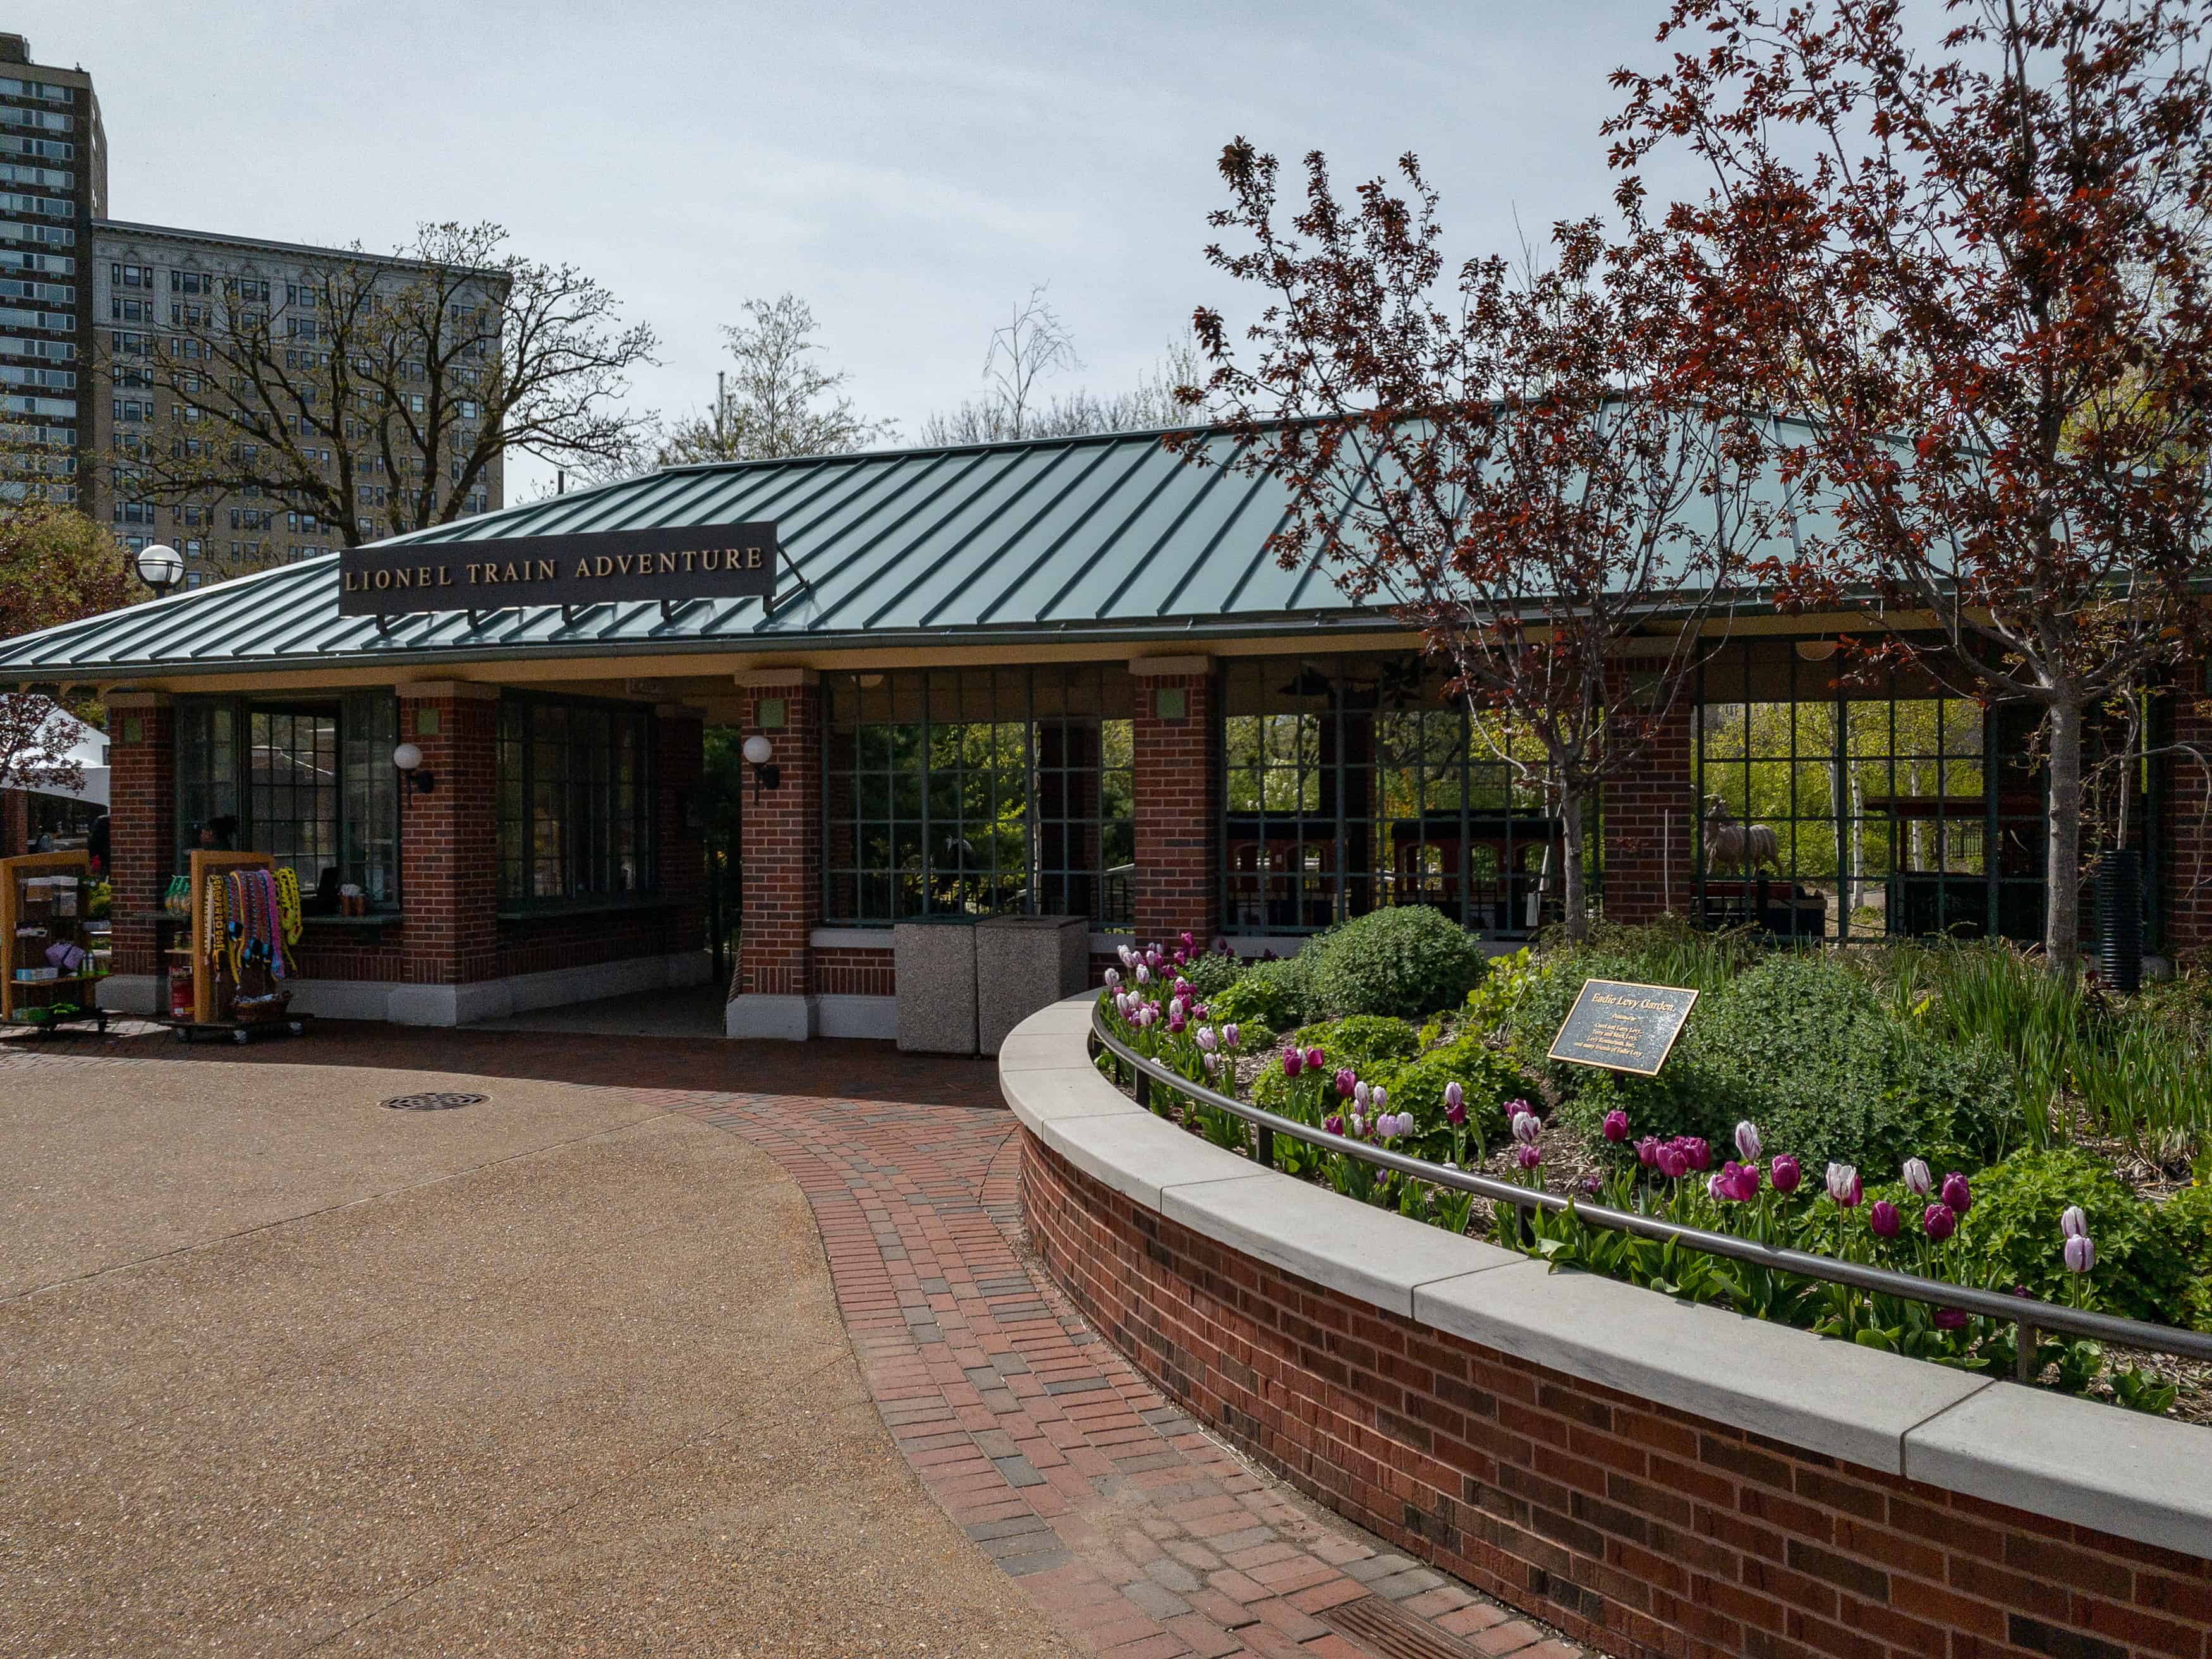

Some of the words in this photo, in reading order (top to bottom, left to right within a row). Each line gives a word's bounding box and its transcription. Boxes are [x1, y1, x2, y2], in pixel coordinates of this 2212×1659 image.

[344, 566, 452, 592] LIONEL
[466, 559, 556, 583] TRAIN
[575, 547, 762, 577] ADVENTURE
[1592, 993, 1616, 1004] Eadie
[1617, 996, 1639, 1009] Levy
